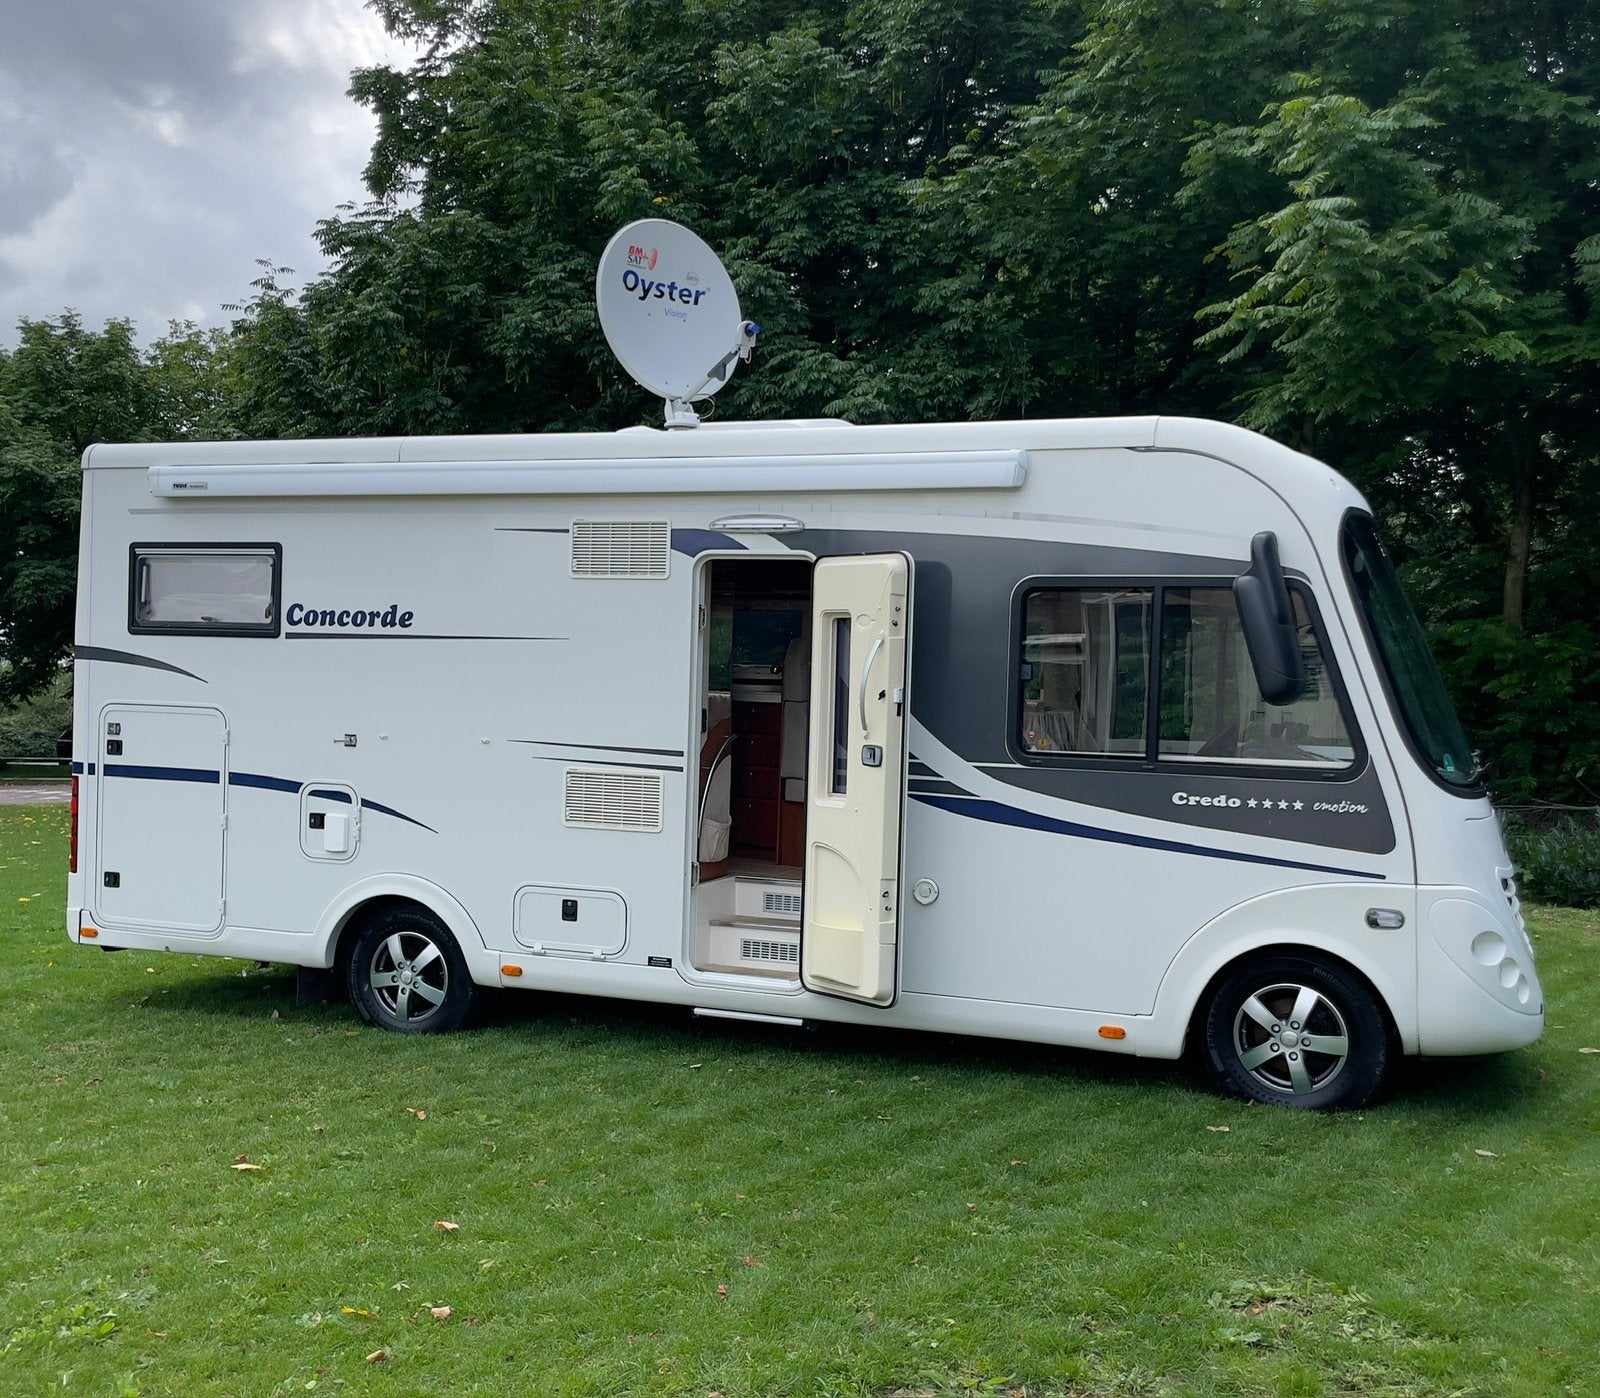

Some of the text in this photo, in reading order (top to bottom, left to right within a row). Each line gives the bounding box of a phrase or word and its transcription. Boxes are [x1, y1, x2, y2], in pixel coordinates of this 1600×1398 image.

[627, 254, 642, 265] SAT
[628, 244, 644, 257] BM
[622, 269, 706, 306] Oyster
[664, 307, 688, 319] Vision
[285, 602, 414, 629] Concorde
[1171, 791, 1369, 815] Credo emotion
